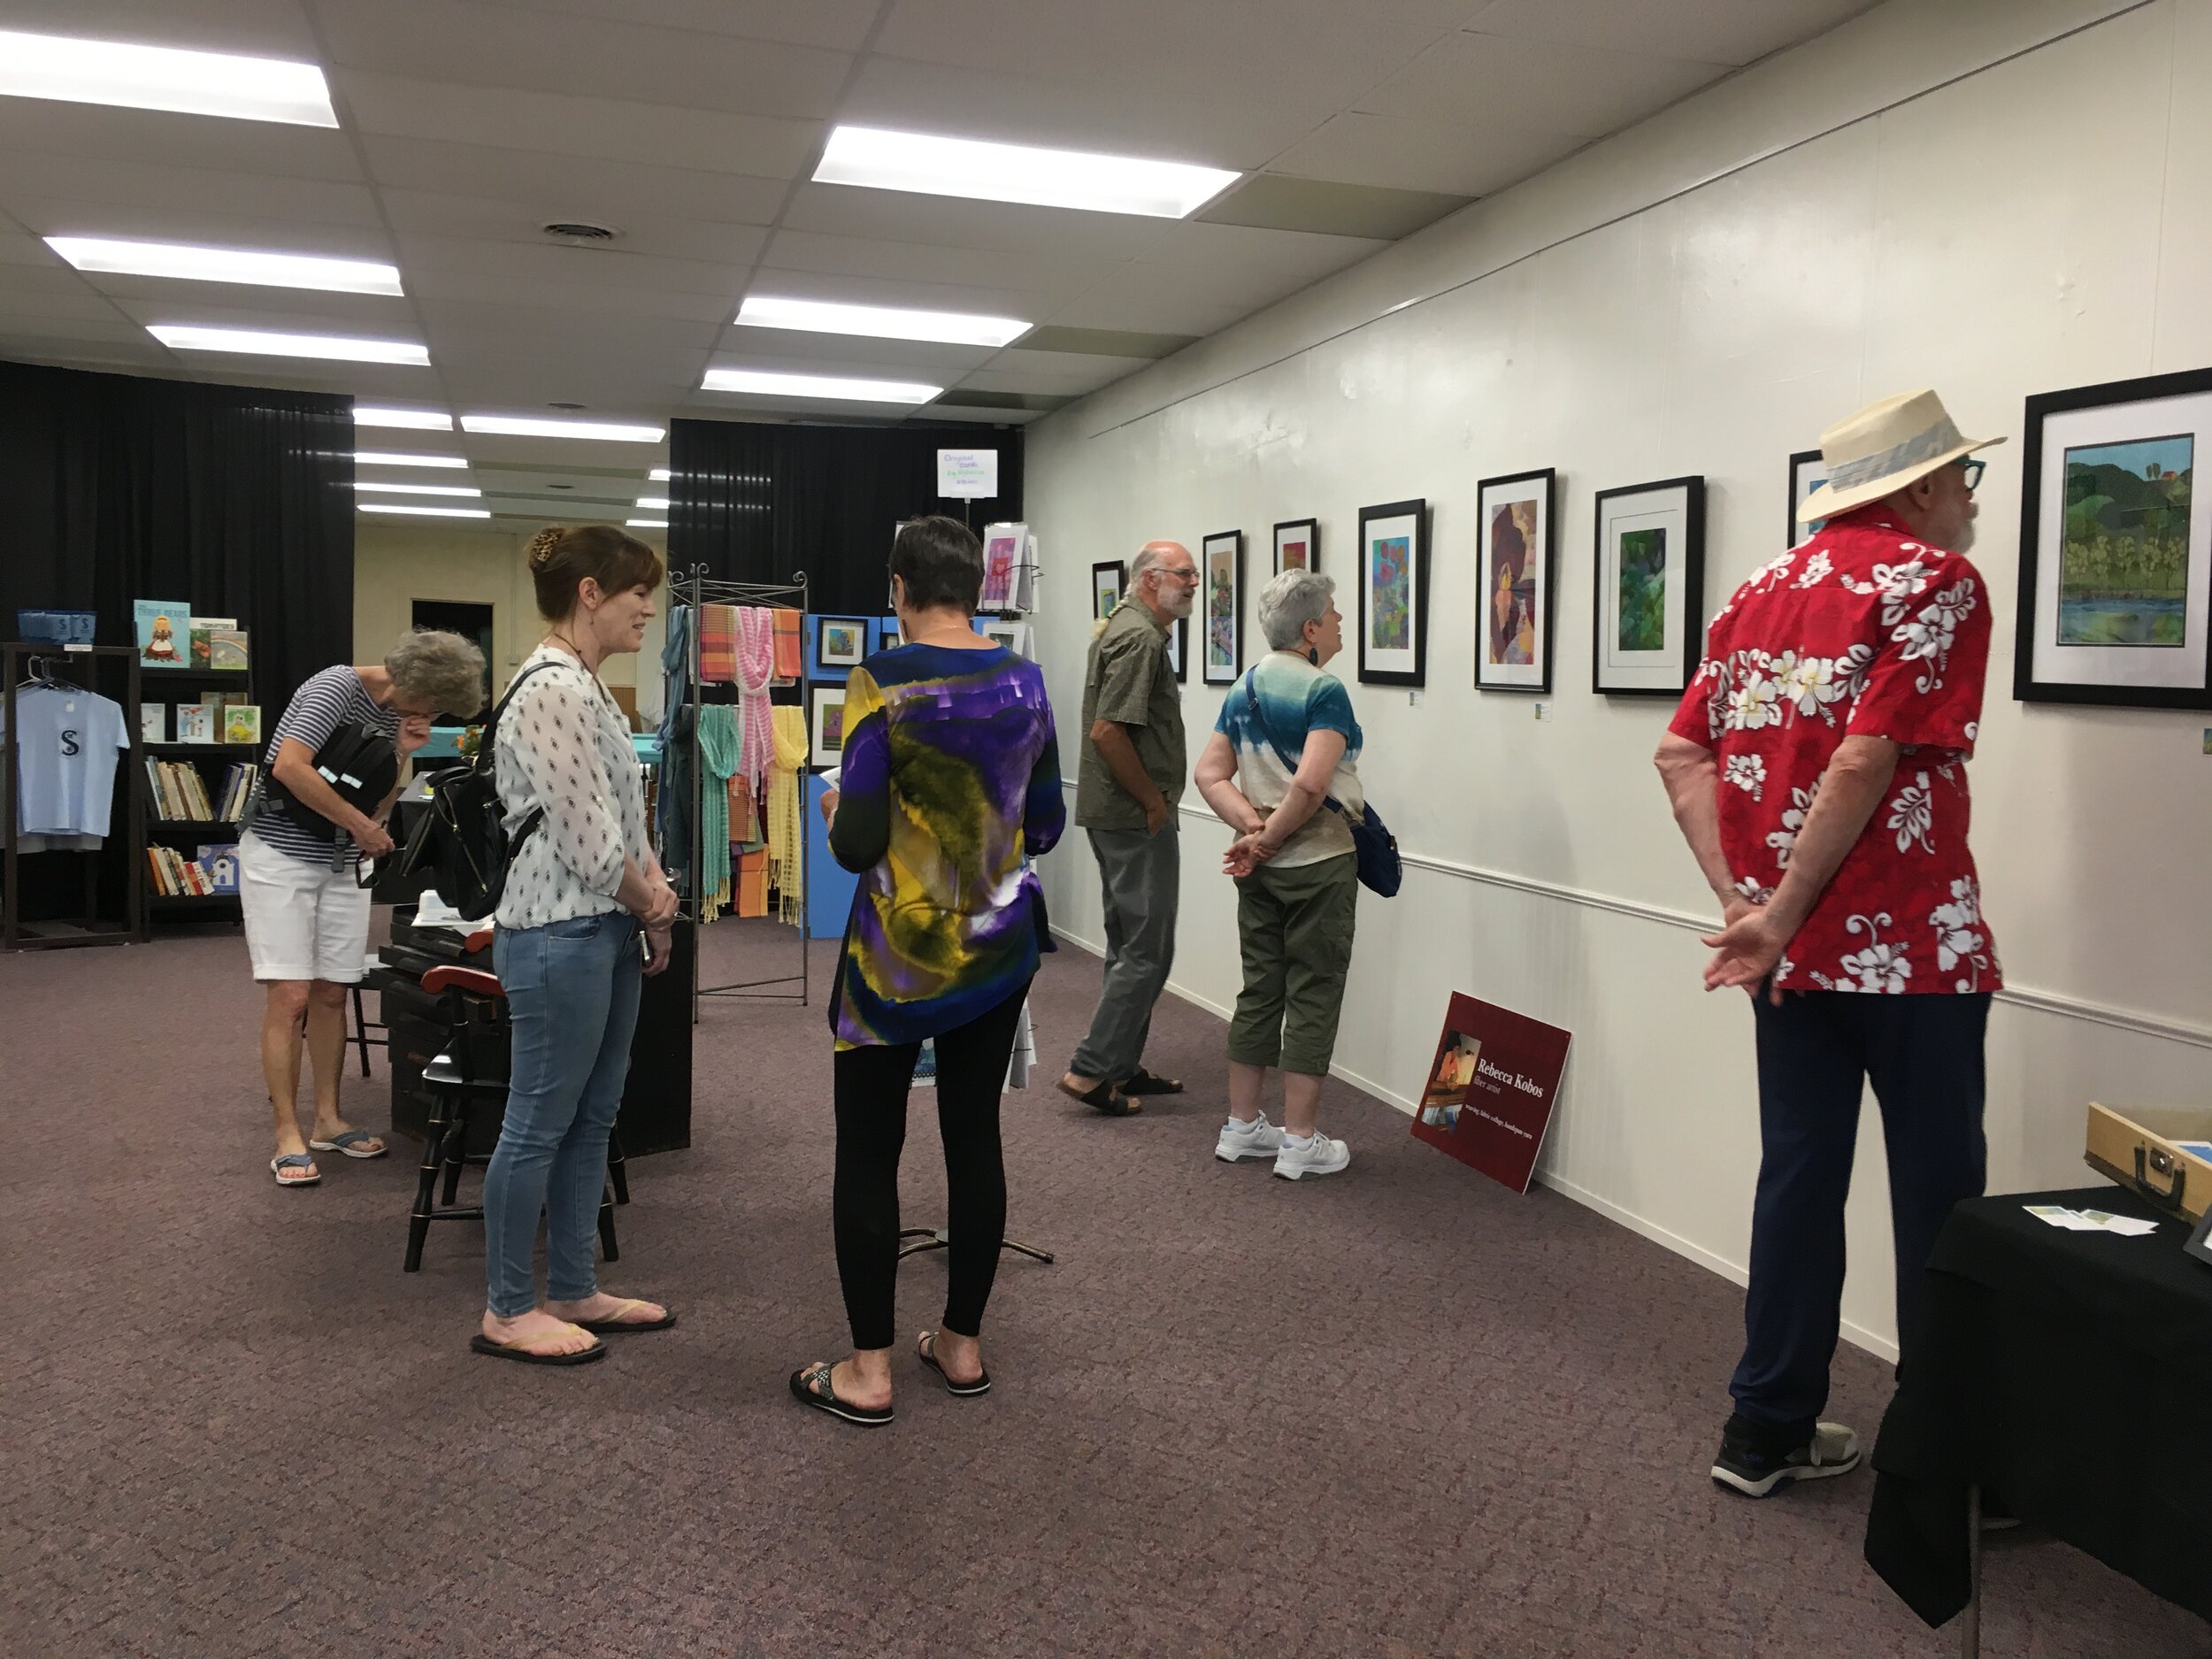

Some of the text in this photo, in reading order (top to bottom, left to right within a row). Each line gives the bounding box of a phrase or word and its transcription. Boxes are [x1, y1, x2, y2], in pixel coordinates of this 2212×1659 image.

[61, 729, 80, 757] S
[1477, 1058, 1544, 1098] Rebecca Kobos
